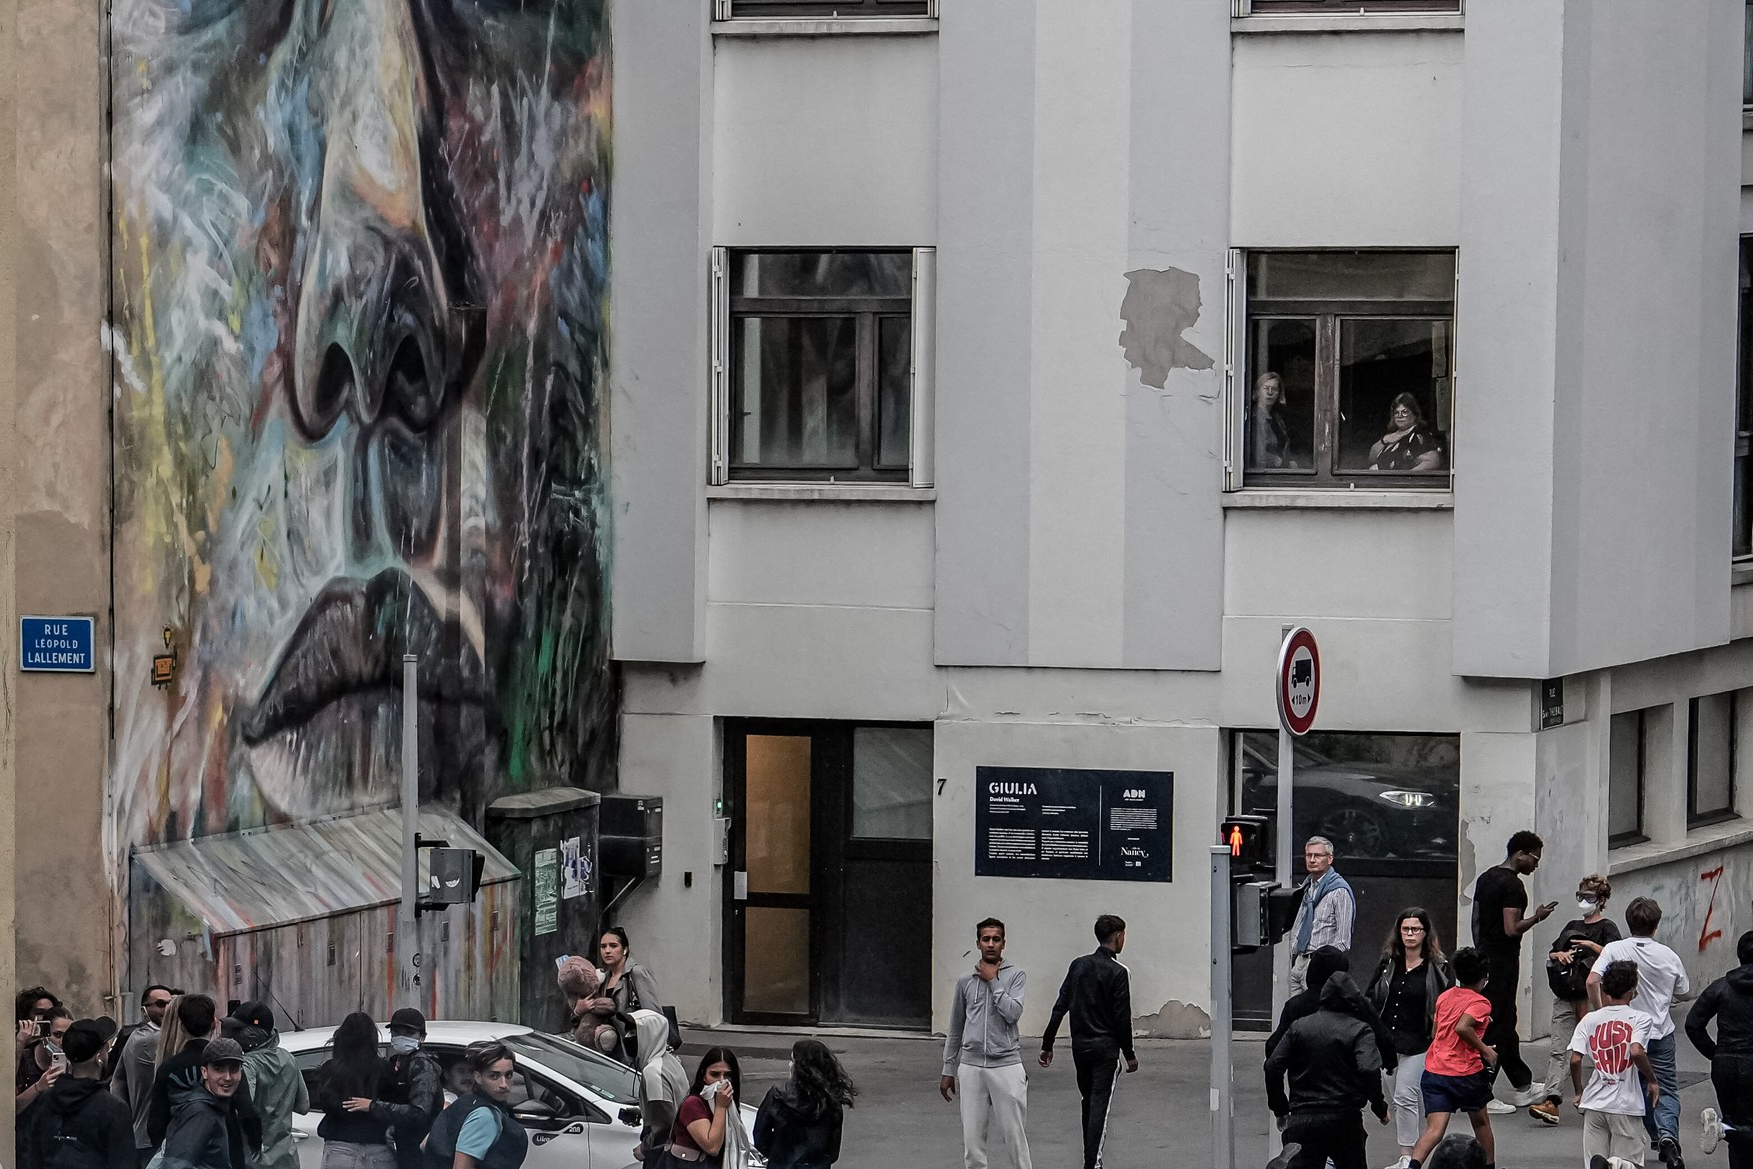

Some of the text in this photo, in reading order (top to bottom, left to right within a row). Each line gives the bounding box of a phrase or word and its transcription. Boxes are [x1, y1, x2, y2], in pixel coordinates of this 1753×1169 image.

[44, 623, 68, 636] RUE
[35, 637, 78, 649] LÉOPOLD
[28, 651, 86, 664] LALLEMENT
[936, 778, 948, 796] 7
[988, 782, 1038, 796] GIULIA
[1123, 789, 1146, 799] ADN
[1589, 1020, 1634, 1051] JUST
